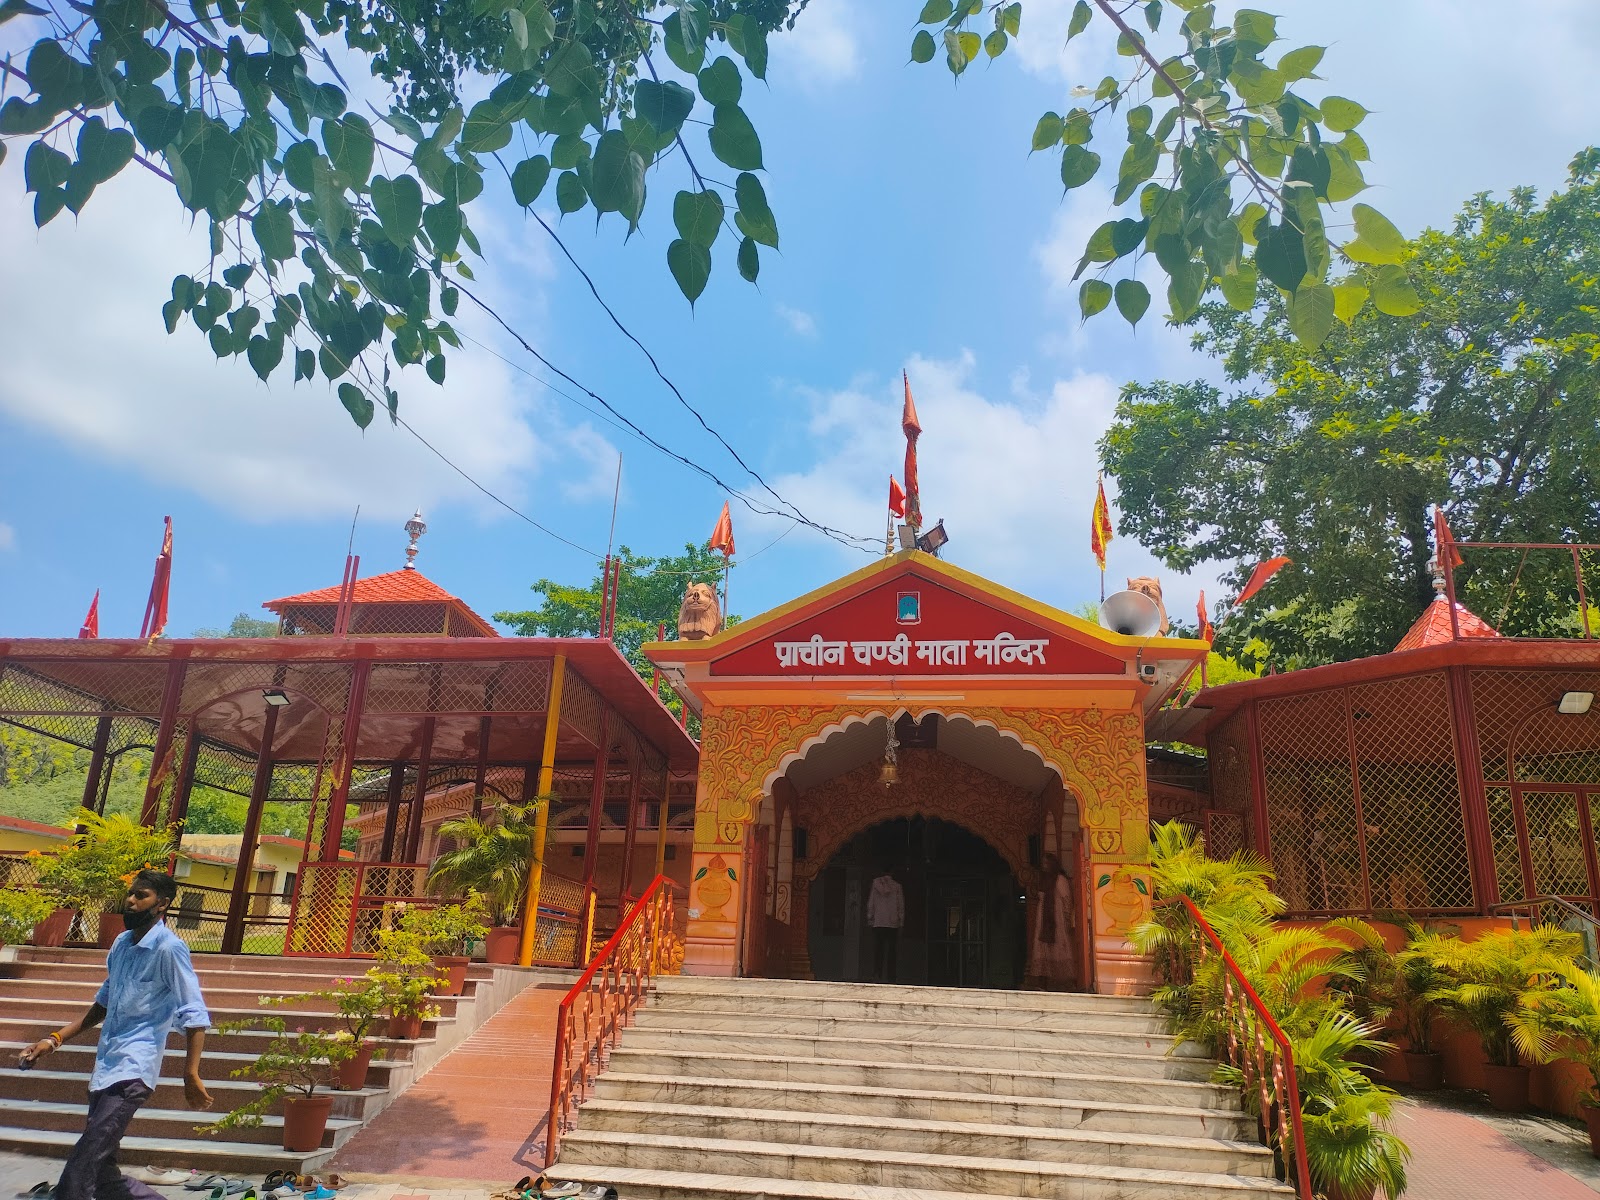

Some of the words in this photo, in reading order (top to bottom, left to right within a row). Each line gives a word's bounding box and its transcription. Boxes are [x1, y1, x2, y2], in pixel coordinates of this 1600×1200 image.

[773, 634, 848, 668] प्राचीन
[850, 633, 912, 666] चण्डी
[914, 640, 970, 666] माता
[972, 631, 1050, 666] मन्दिर
